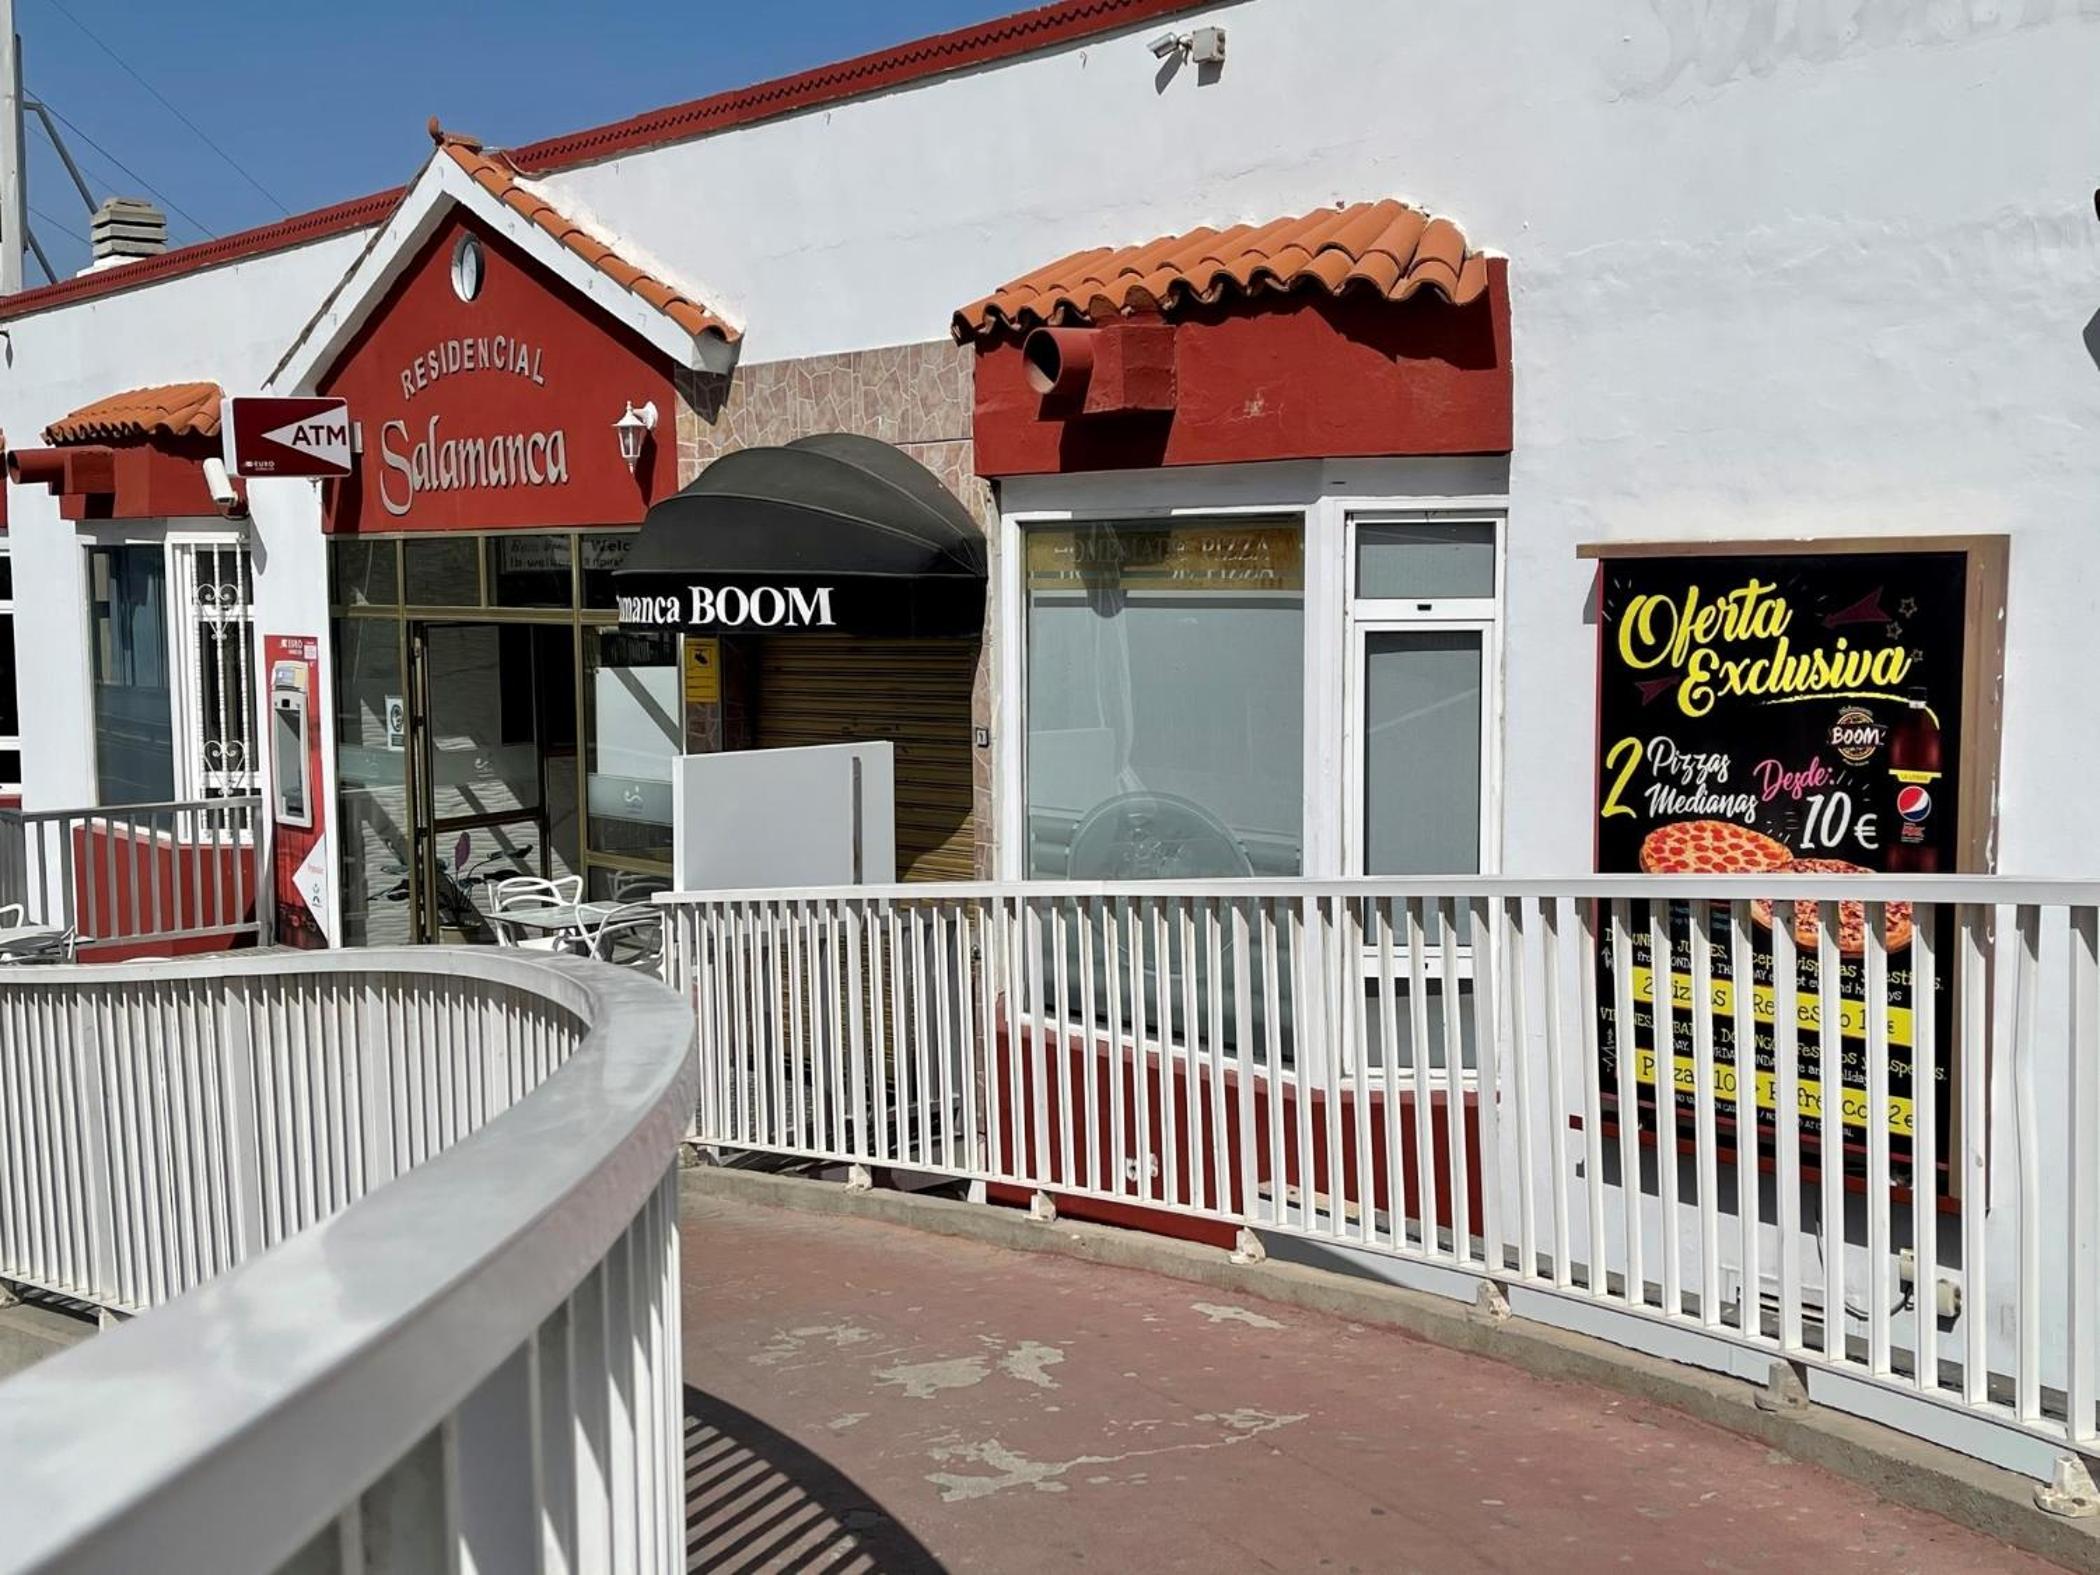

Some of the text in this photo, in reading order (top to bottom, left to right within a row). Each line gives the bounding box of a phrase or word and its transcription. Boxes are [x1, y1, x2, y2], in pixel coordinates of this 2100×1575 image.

[400, 334, 546, 401] RESIDENCIAL
[291, 424, 347, 447] ATM
[380, 414, 569, 516] Salamanca
[616, 585, 837, 626] manca BOOM
[1618, 578, 1793, 670] Oferta
[1677, 636, 1913, 718] Exclusiva
[1646, 735, 1732, 785] Pizzas
[1831, 725, 1881, 745] BOOM
[1600, 735, 1644, 819] 2
[1753, 755, 1836, 802] Desde:
[1644, 782, 1758, 824] Medianas
